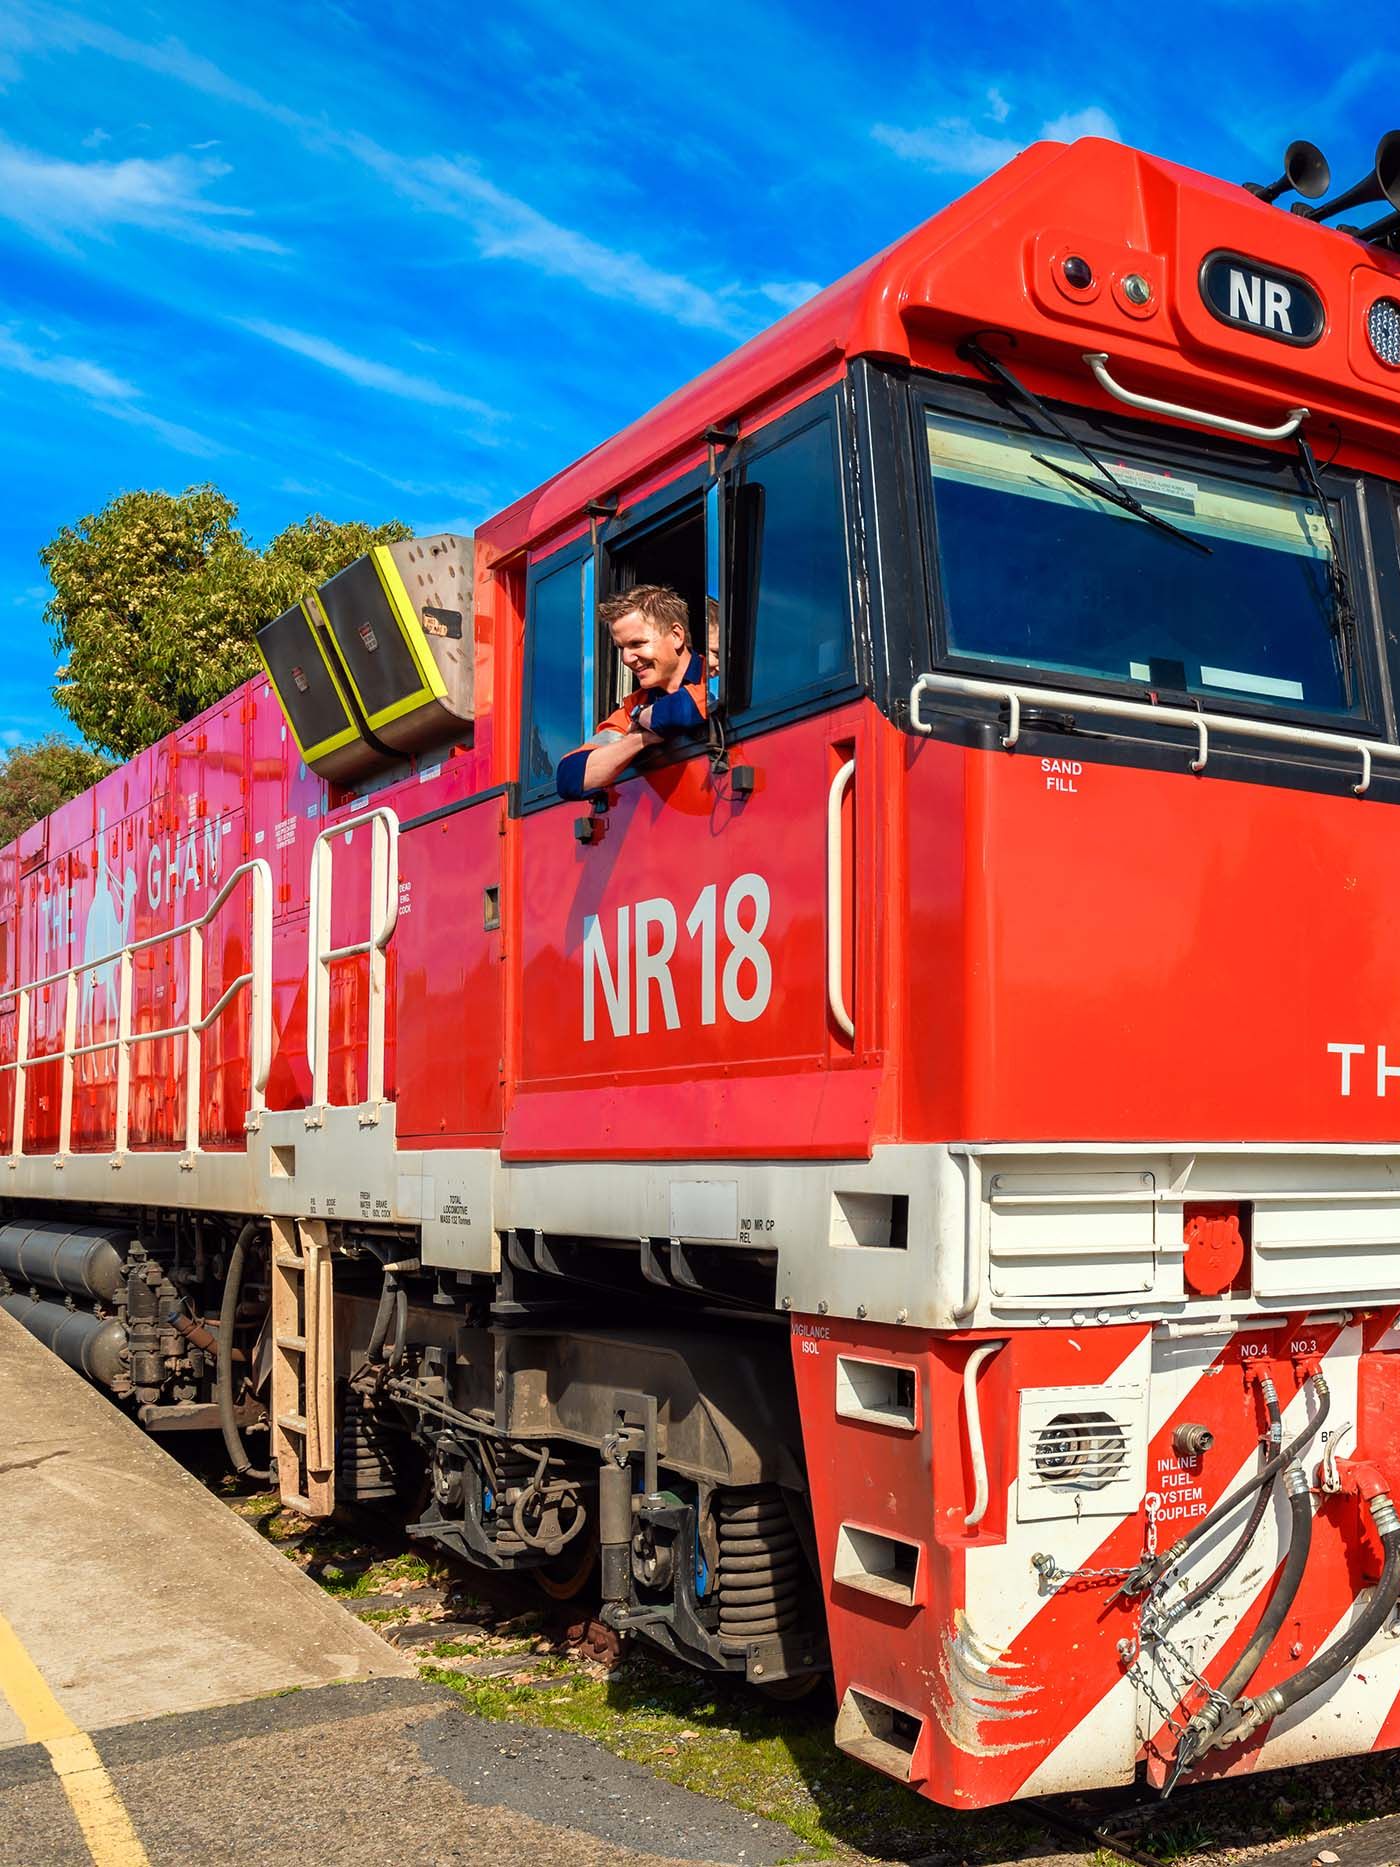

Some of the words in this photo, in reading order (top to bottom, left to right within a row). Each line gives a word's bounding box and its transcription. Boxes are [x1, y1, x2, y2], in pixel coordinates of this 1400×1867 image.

[1230, 268, 1293, 334] NR
[1041, 758, 1082, 776] SAND
[1046, 776, 1078, 793] FILL
[41, 886, 77, 953] THE
[147, 813, 221, 911] GHAN
[399, 881, 412, 893] DEAD
[399, 904, 412, 915] COCK
[583, 873, 773, 1042] NR18
[360, 1200, 371, 1210] WATER
[375, 1199, 388, 1209] BRAKE
[449, 1195, 463, 1205] TOTAL
[381, 1209, 392, 1218] COCK
[442, 1205, 469, 1216] LOCOMOTIVE
[440, 1214, 451, 1224] MASS
[740, 1218, 751, 1230] IND
[754, 1218, 763, 1231] MR
[765, 1219, 775, 1231] CP
[739, 1231, 751, 1244] REL
[791, 1324, 830, 1339] VIGILANCE
[802, 1341, 819, 1354] ISOL
[1240, 1343, 1269, 1357] NO.4
[1290, 1339, 1317, 1353] NO.3
[1157, 1455, 1198, 1473] INLINE
[1161, 1472, 1194, 1489] FUEL
[1157, 1487, 1203, 1505] YSTEM
